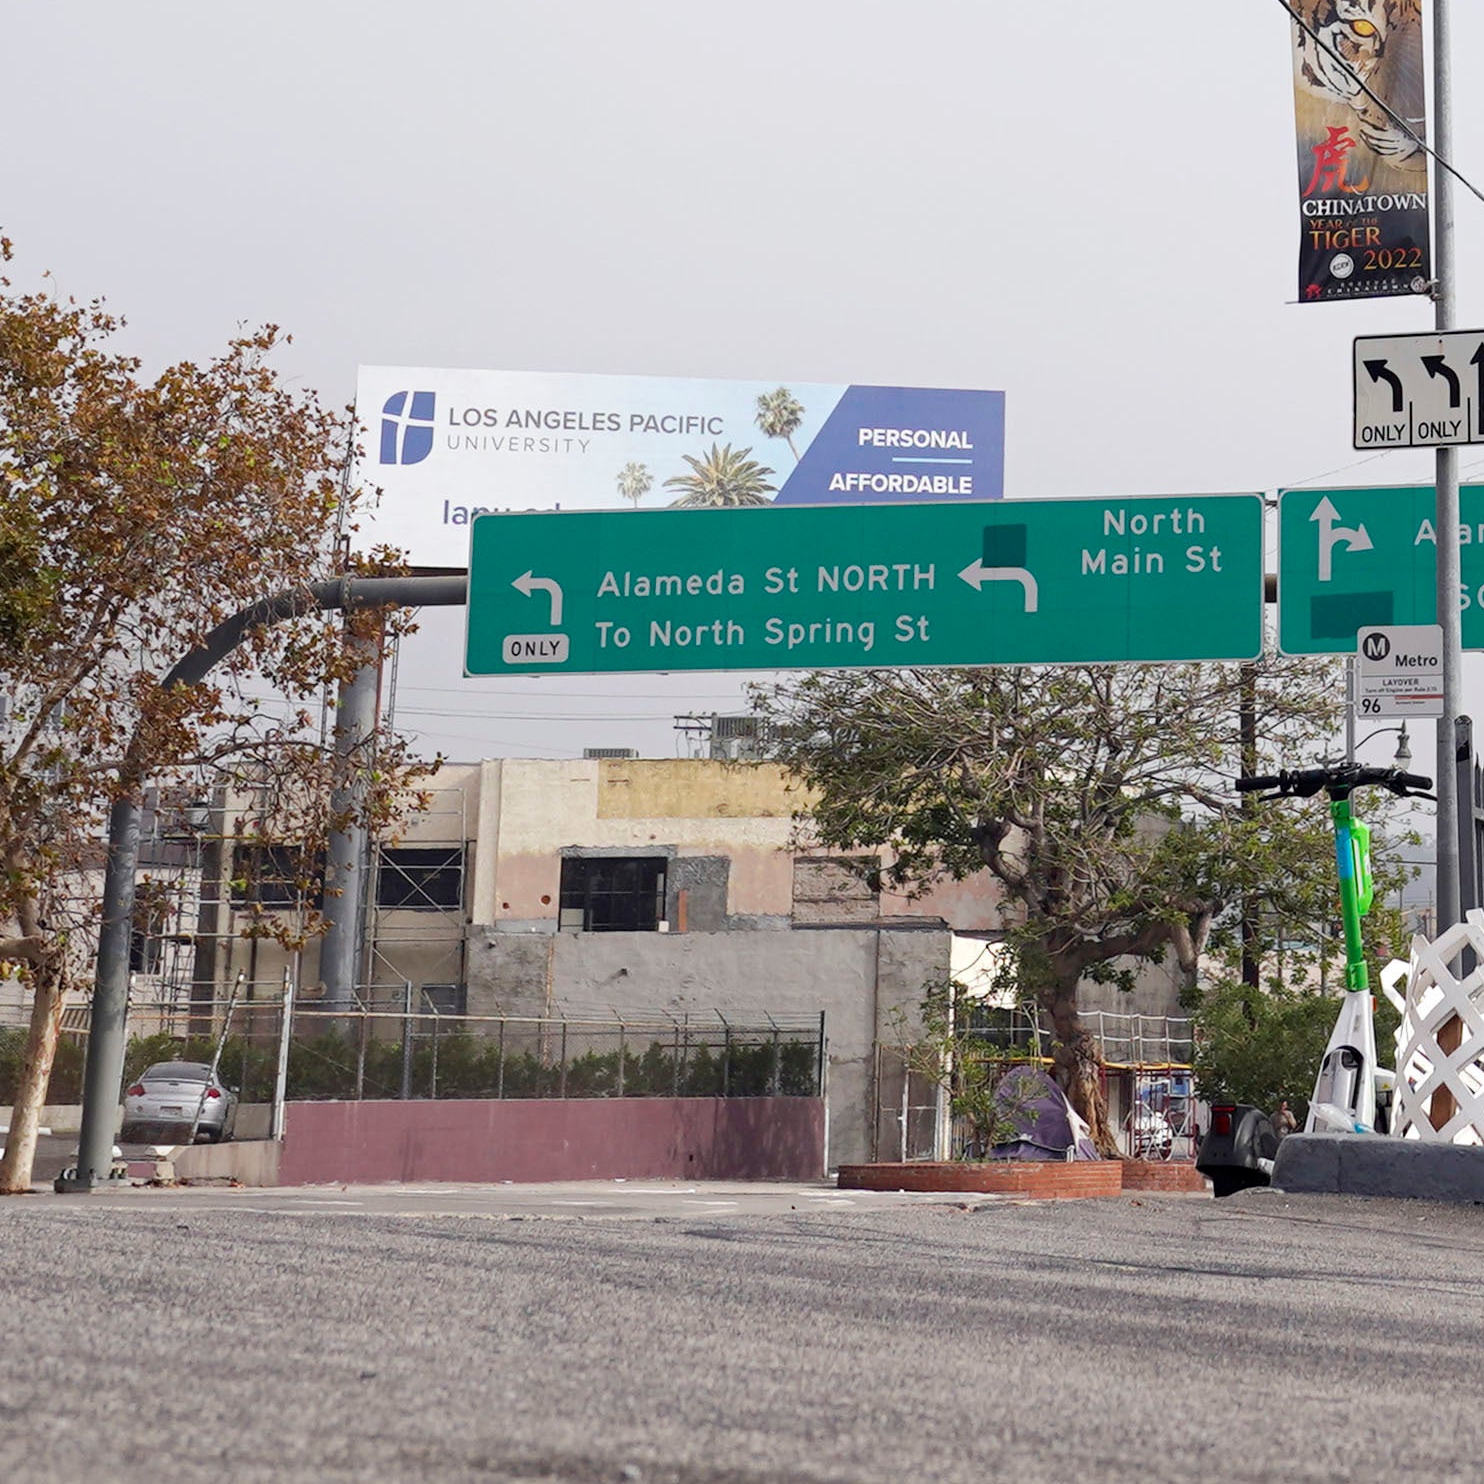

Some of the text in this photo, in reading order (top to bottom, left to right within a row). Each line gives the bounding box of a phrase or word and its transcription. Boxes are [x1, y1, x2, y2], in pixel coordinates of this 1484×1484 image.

[1302, 193, 1427, 216] CHINATOWN
[1309, 219, 1343, 229] YEAR
[1309, 226, 1381, 250] TIGER
[1364, 248, 1423, 270] 2022
[449, 407, 724, 436] LOS ANGELES PACIFIC
[1362, 419, 1462, 444] ONLY ONLY
[447, 435, 591, 455] UNIVERSITY
[858, 427, 973, 450] PERSONAL
[829, 473, 972, 495] AFFORDABLE
[1103, 509, 1205, 536] North
[1081, 546, 1223, 575] Main St
[597, 564, 935, 599] Alameda St NORTH
[596, 616, 930, 651] To North Spring St
[511, 640, 560, 659] ONLY
[1395, 654, 1438, 667] Metro
[1382, 678, 1420, 687] LAYOVER
[1362, 698, 1381, 714] 96
